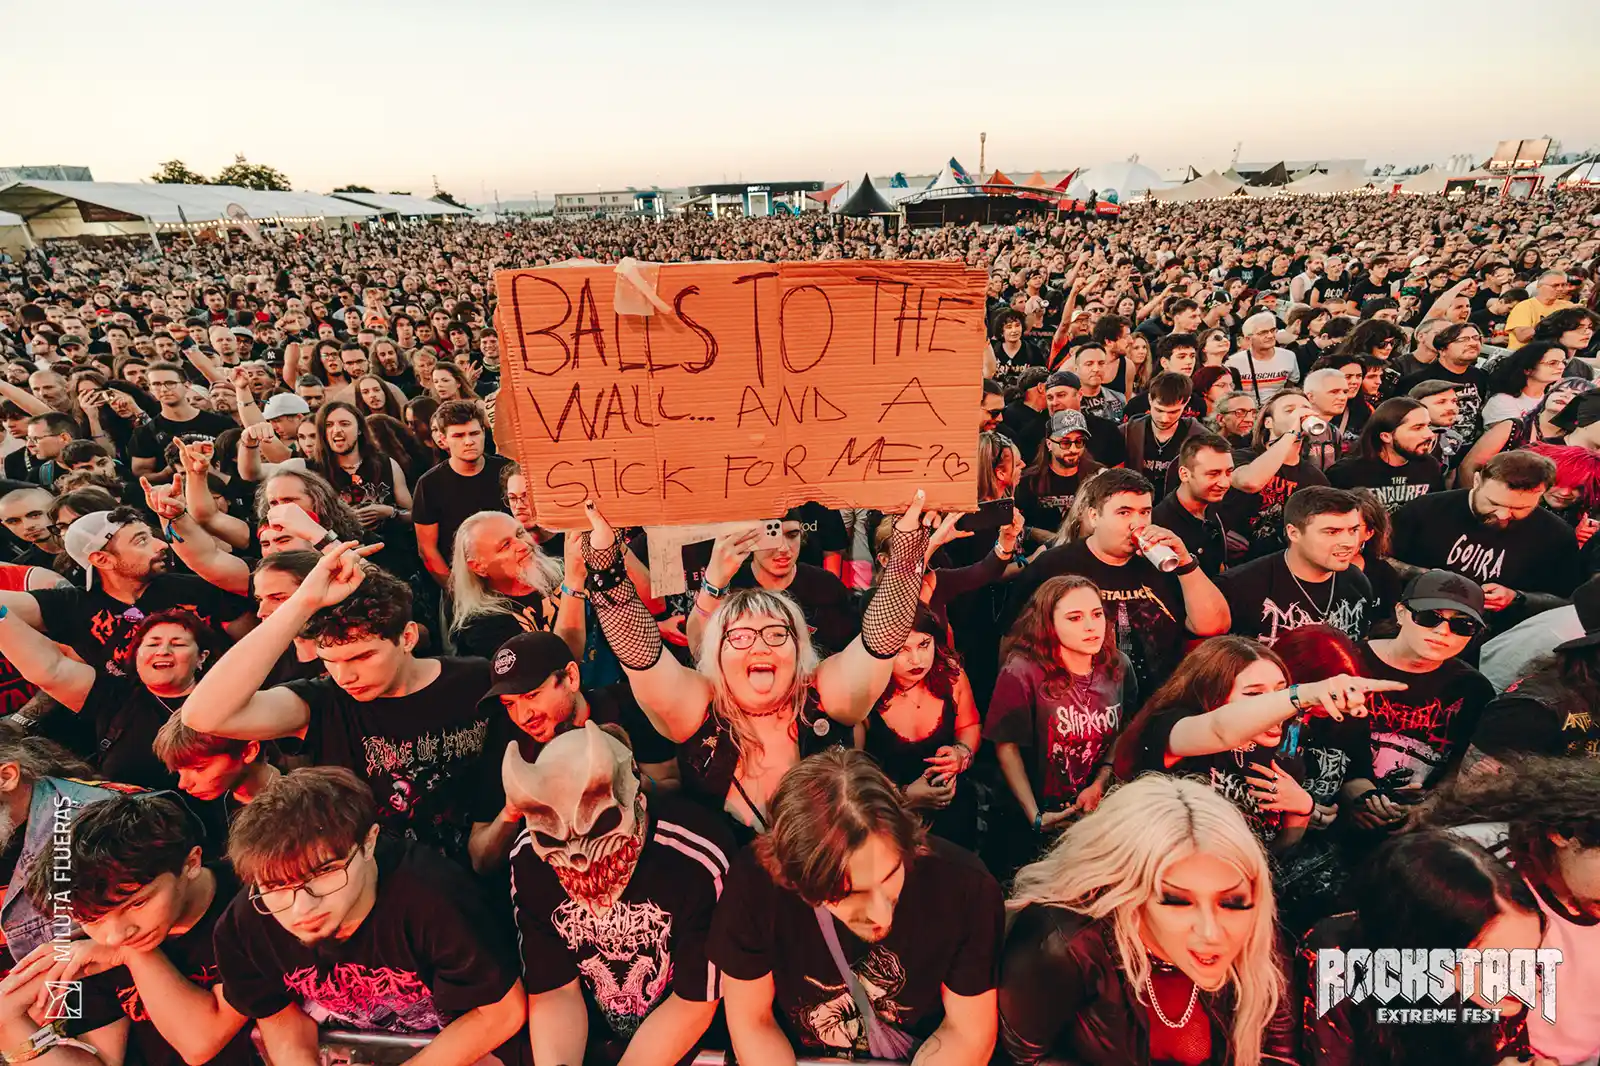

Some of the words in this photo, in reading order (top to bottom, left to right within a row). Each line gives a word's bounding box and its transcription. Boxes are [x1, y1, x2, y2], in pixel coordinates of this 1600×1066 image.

[512, 274, 718, 378] BALLS
[733, 272, 833, 387] TO
[856, 276, 975, 365] THE
[737, 385, 847, 428] AND
[878, 377, 946, 426] A
[546, 448, 695, 507] STICK
[724, 444, 807, 499] FOR
[828, 436, 944, 482] ME?
[1391, 476, 1408, 484] THE
[1446, 533, 1506, 582] GOJIRA
